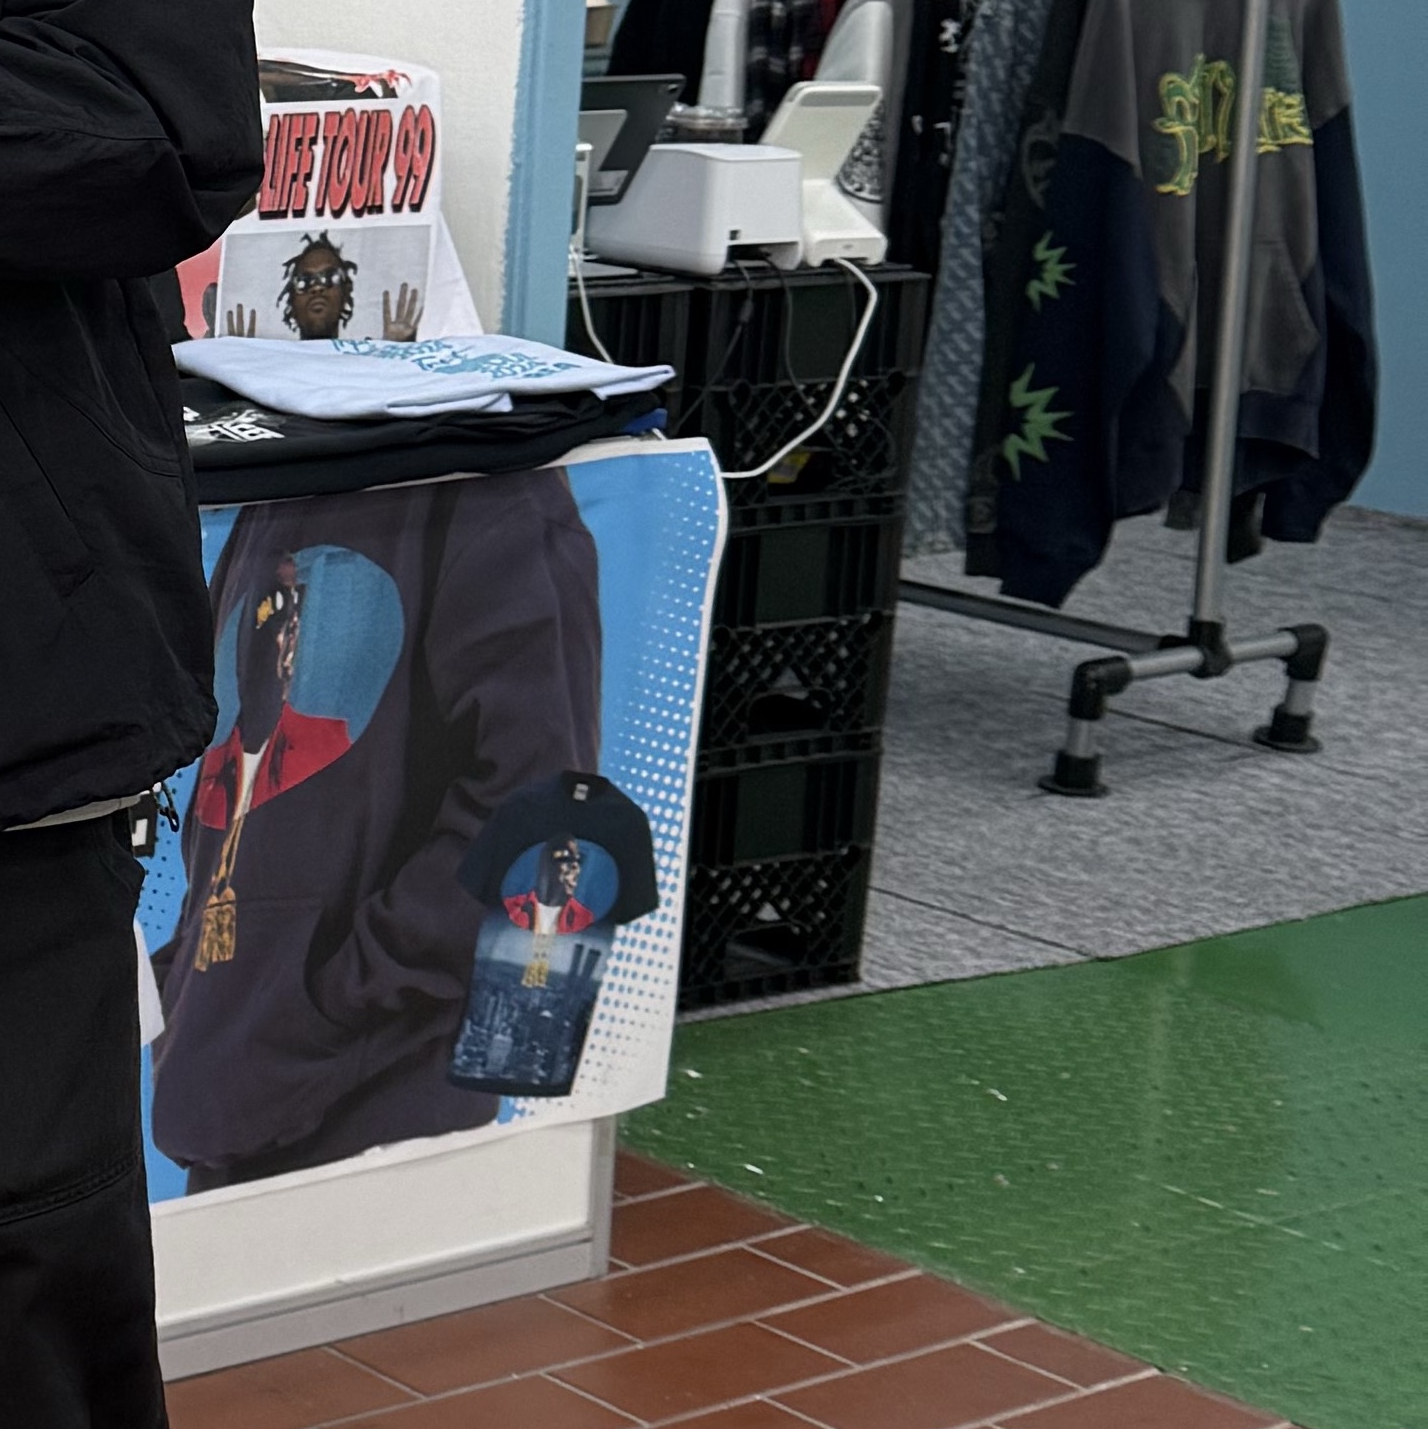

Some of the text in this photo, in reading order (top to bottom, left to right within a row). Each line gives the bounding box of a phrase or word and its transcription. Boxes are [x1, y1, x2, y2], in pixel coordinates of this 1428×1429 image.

[259, 103, 436, 220] LIFE TOUR 99
